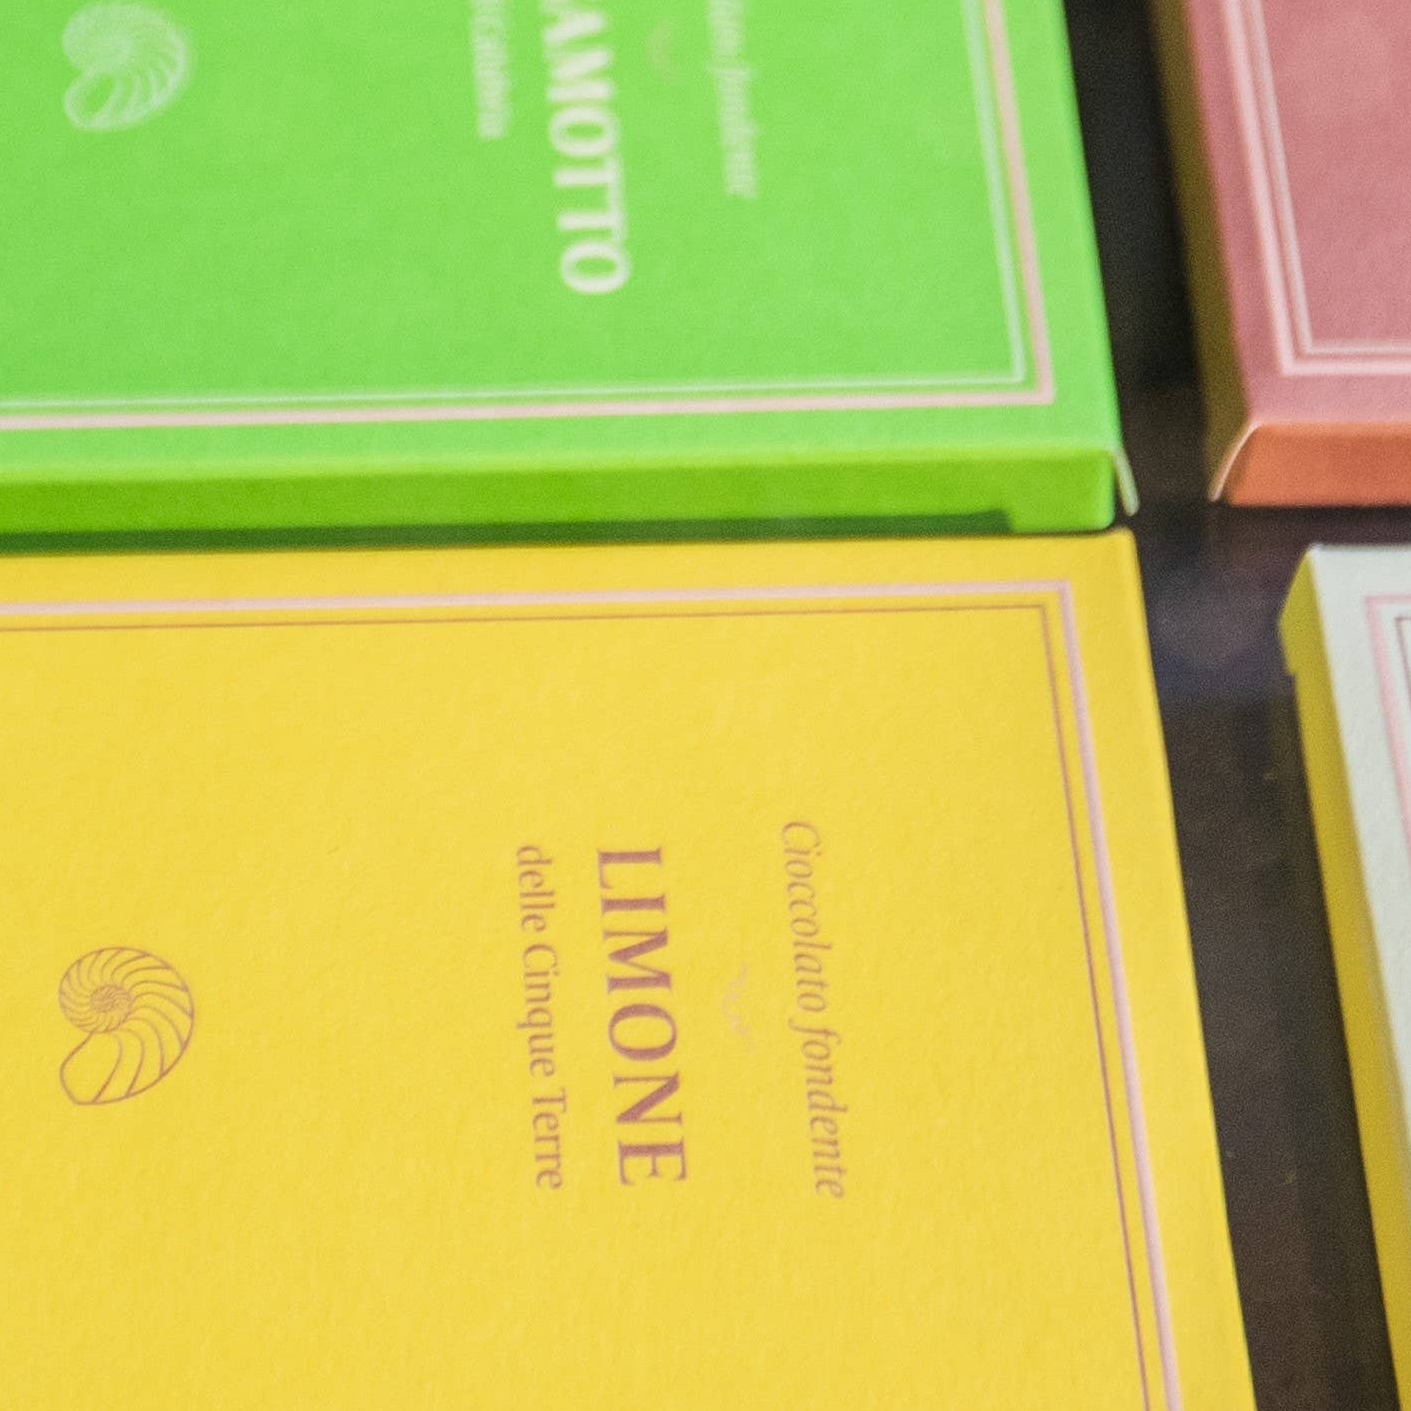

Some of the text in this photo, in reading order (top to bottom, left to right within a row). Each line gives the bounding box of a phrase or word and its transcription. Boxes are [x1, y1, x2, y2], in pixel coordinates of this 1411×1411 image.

[515, 844, 567, 1191] delle Cinque Terre
[596, 846, 688, 1186] LIMONE
[781, 820, 849, 1199] Cioccolato fondente
